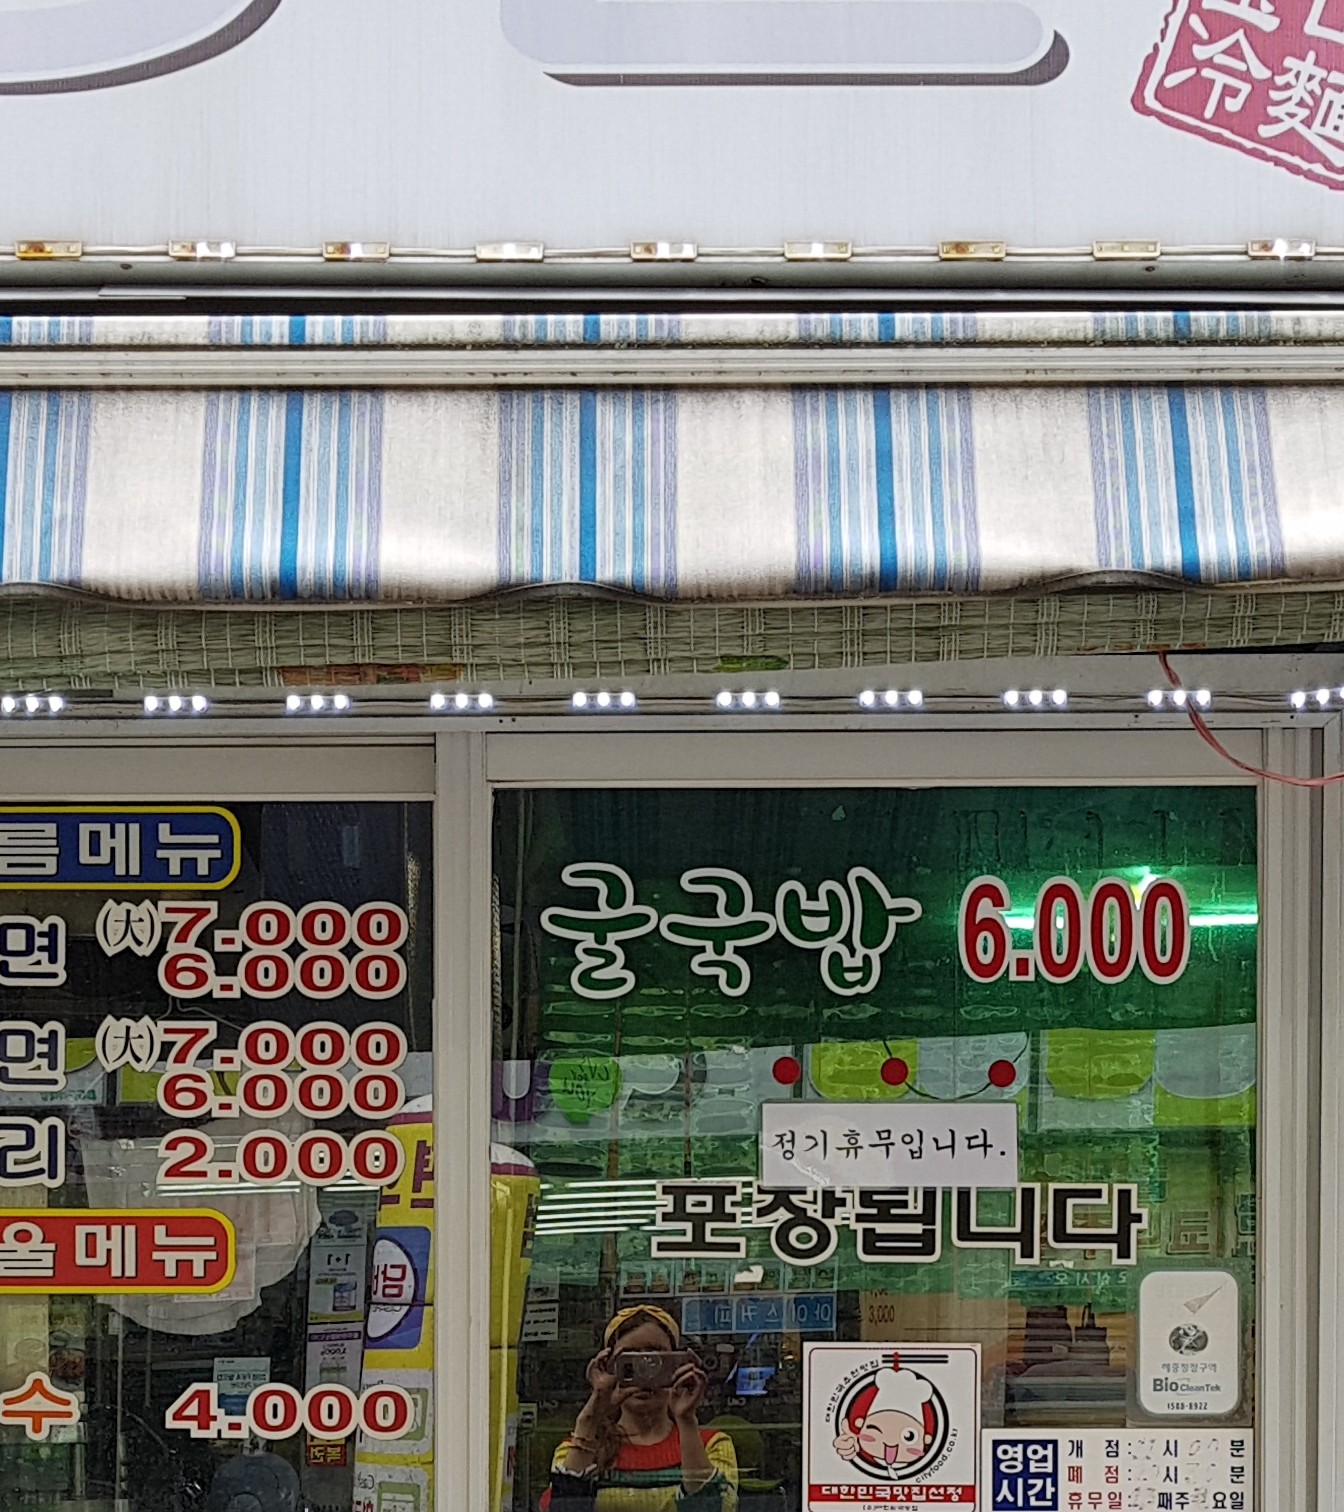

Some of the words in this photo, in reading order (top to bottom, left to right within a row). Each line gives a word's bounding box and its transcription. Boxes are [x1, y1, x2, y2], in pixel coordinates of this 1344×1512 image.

[541, 862, 922, 999] 굴국밥
[958, 874, 1191, 985] 6.000
[157, 948, 408, 1000] 6.000
[157, 1067, 408, 1120] 6.000
[157, 1128, 406, 1188] 2.000
[165, 1382, 418, 1440] 4.000
[996, 1443, 1054, 1474] 영업
[995, 1477, 1056, 1508] 시간
